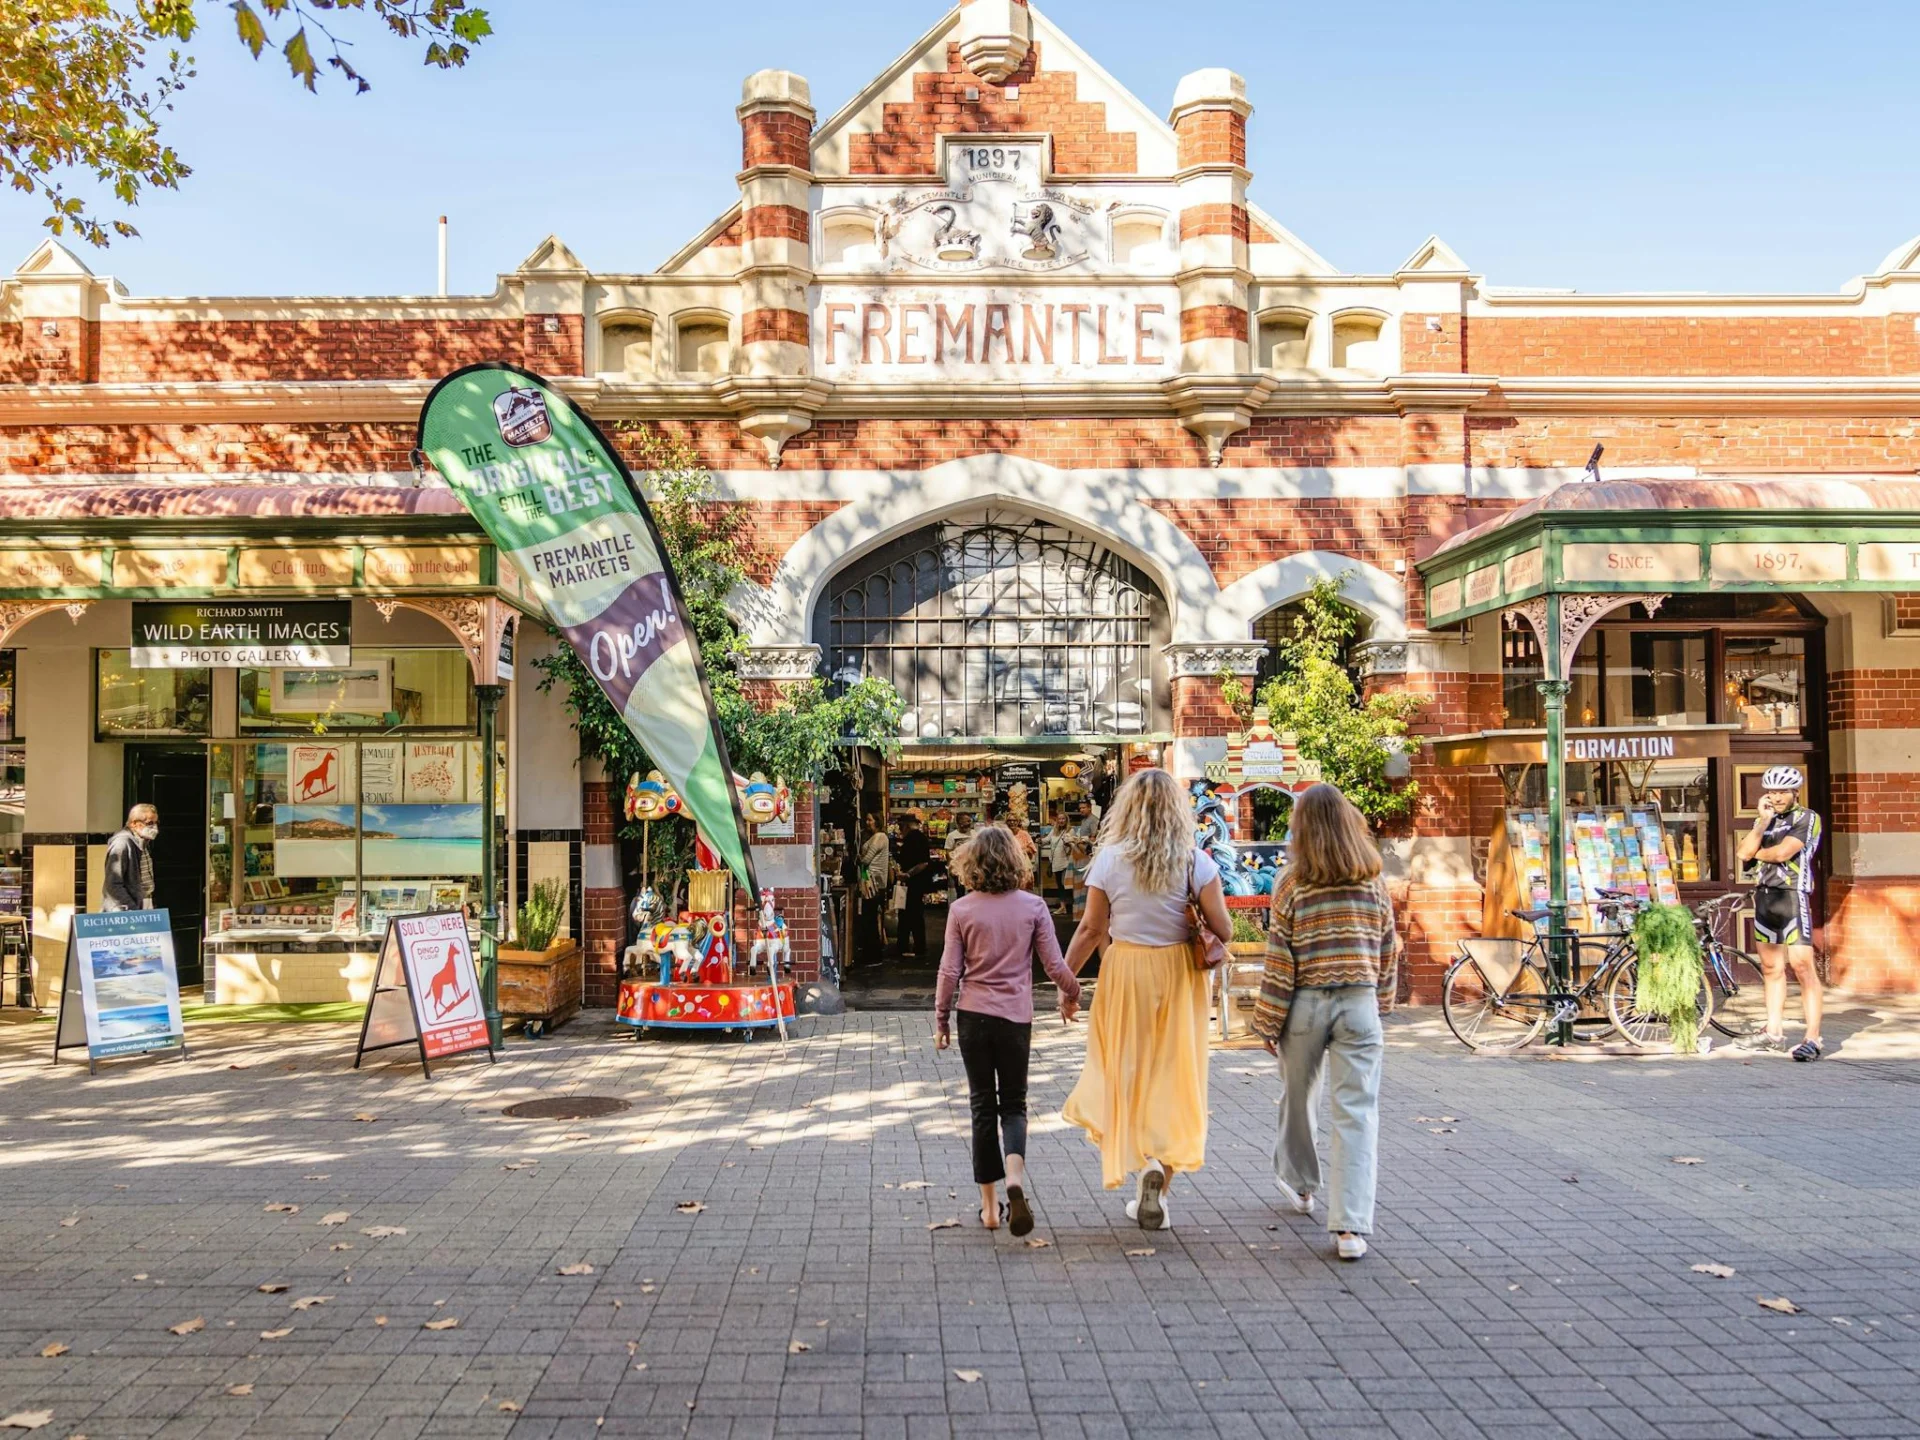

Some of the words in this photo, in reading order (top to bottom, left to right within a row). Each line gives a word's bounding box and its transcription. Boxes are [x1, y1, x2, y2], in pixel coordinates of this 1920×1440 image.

[966, 149, 1021, 170] 1897
[825, 303, 1165, 365] FREMANTLE
[507, 414, 545, 440] MARKETS
[461, 443, 496, 466] THE
[468, 447, 592, 497] ORIGINAL
[585, 449, 596, 463] &
[498, 489, 542, 513] STILL
[543, 473, 615, 515] BEST
[524, 506, 545, 521] THE
[532, 533, 636, 572] FREMANTLE
[271, 560, 327, 577] Clothing
[410, 563, 422, 574] on
[425, 559, 442, 574] the
[444, 559, 468, 573] Cob
[548, 554, 631, 588] MARKETS
[196, 608, 246, 618] RICHARD
[248, 607, 283, 617] SMYTH
[144, 624, 193, 641] WILD
[200, 623, 260, 640] EARTH
[268, 622, 340, 639] IMAGES
[590, 577, 676, 682] Open!
[181, 650, 232, 662] PHOTO
[236, 649, 301, 662] GALLERY
[412, 745, 455, 758] AUSTRALIA
[1542, 736, 1673, 760] IFORMATION
[83, 916, 129, 928] RICHARD
[129, 913, 161, 924] SMYTH
[401, 920, 425, 937] SOLD
[440, 916, 464, 933] HERE
[89, 939, 121, 949] PHOTO
[122, 935, 160, 946] GALLERY
[417, 946, 440, 956] DINGO
[100, 1039, 176, 1054] www.richardsmyth.com.au
